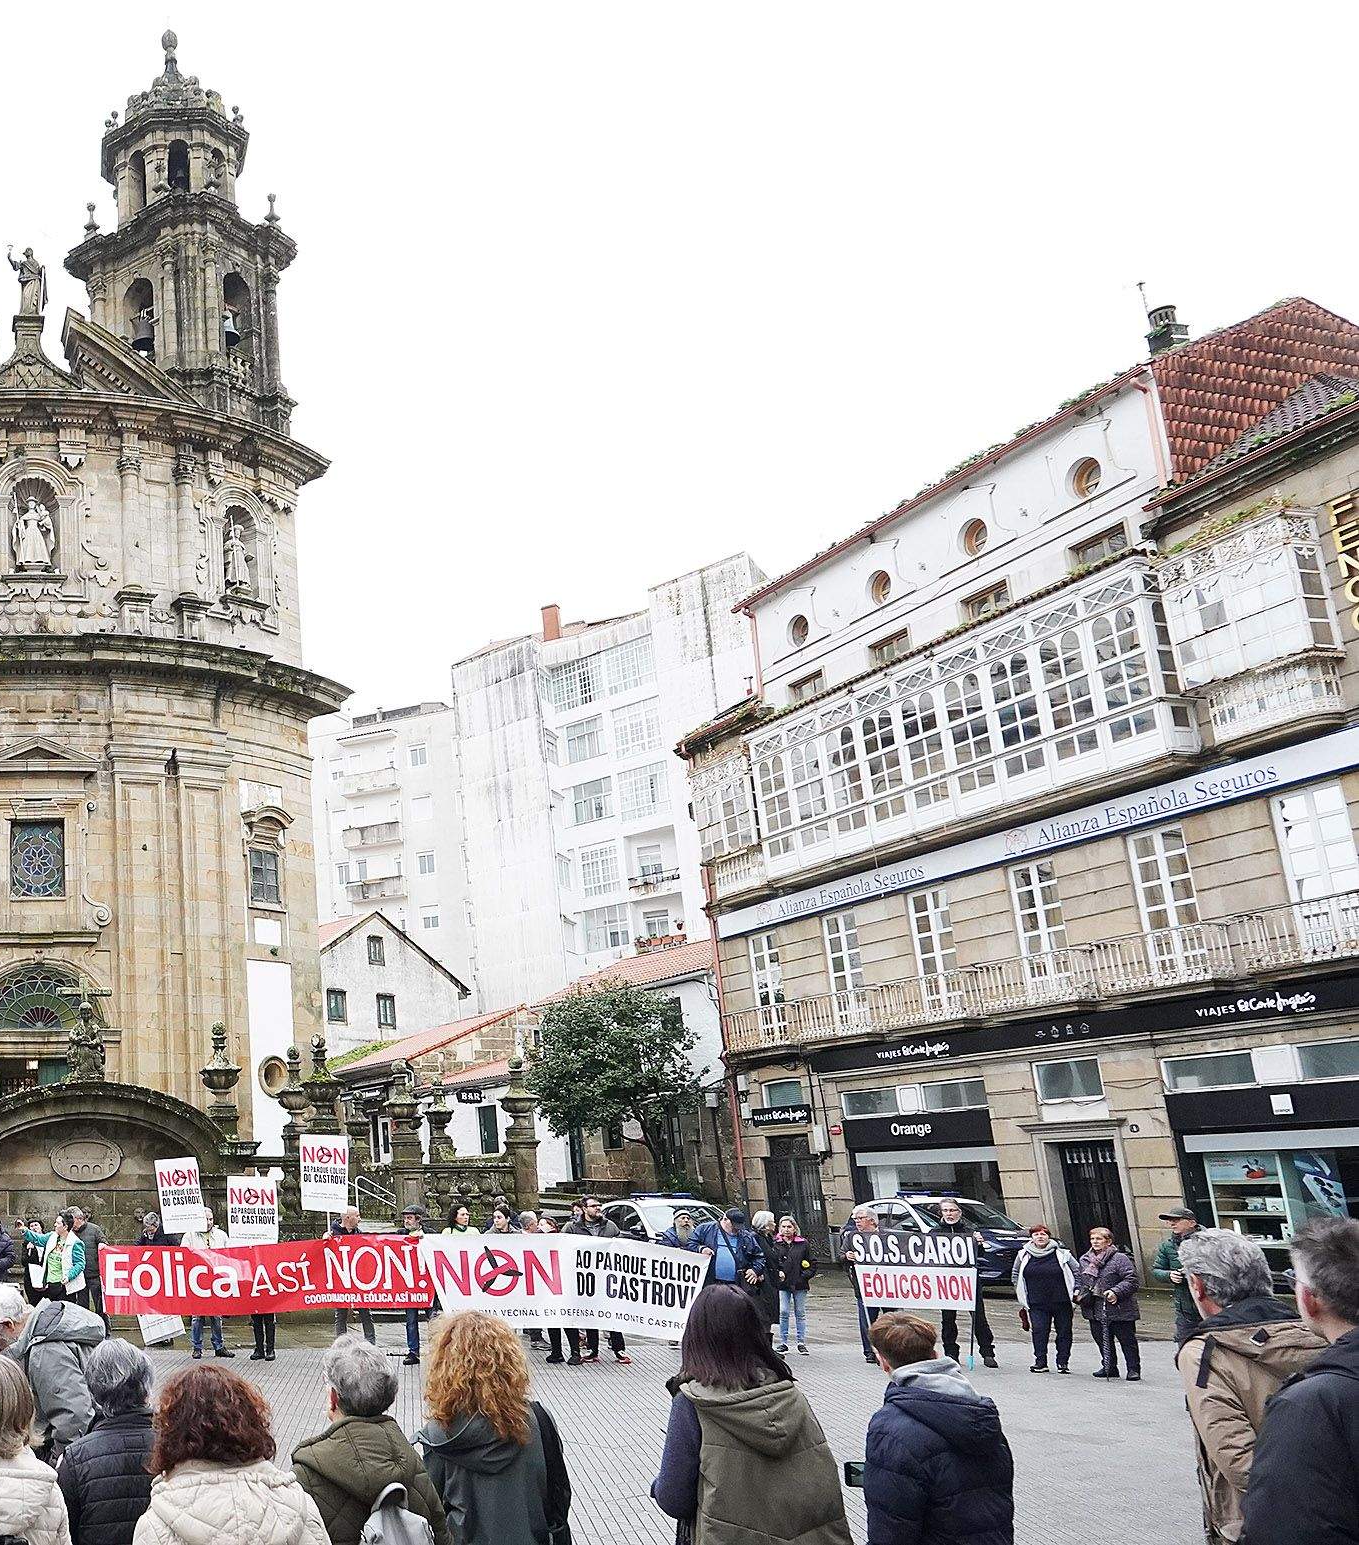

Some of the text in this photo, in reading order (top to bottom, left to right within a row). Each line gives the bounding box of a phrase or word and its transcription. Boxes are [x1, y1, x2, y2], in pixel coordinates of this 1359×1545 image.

[1038, 763, 1278, 844] Alianza Española Seguros
[777, 865, 925, 917] Alianza Española Seguros
[1195, 1004, 1235, 1017] VIAJES
[876, 1049, 901, 1059] VIAJES
[461, 1092, 481, 1100] BAR
[890, 1123, 932, 1137] Orange
[302, 1146, 346, 1165] NON
[159, 1168, 198, 1187] NON
[230, 1187, 275, 1205] NON
[852, 1233, 976, 1266] S.O.S. CAROI
[104, 1244, 429, 1299] Eólica ASÍ NON!
[433, 1247, 563, 1297] NON
[576, 1249, 701, 1284] AO PARQUE EÓLICO
[576, 1271, 596, 1297] DO
[862, 1267, 973, 1301] EÓLICOS NON
[363, 1290, 393, 1302] EÓLICA
[394, 1290, 410, 1302] ASÍ
[410, 1292, 429, 1303] NON
[543, 1308, 557, 1316] EN
[560, 1308, 594, 1318] DEFENSA
[597, 1310, 612, 1318] DO
[615, 1312, 644, 1324] MONTE
